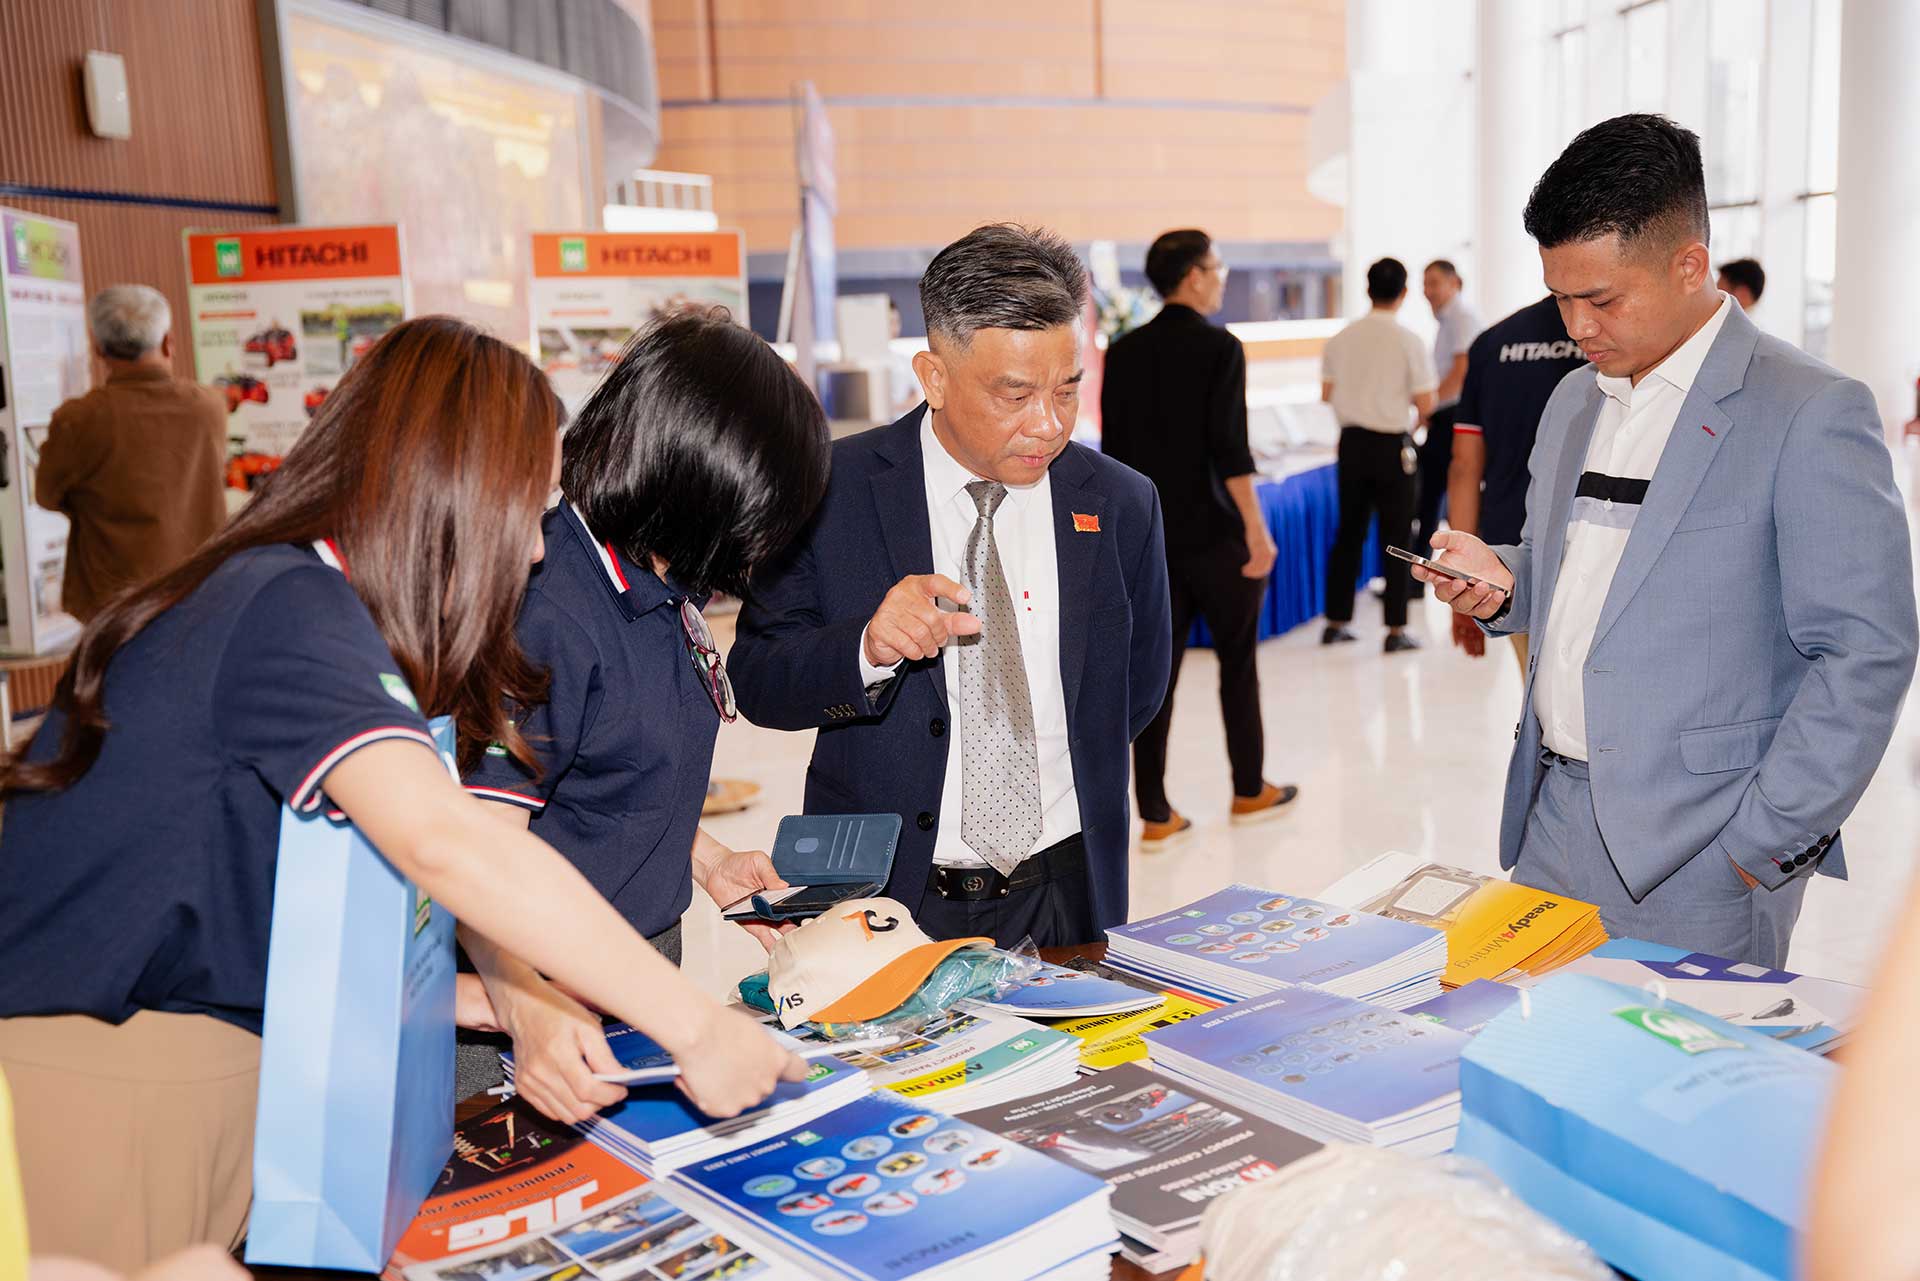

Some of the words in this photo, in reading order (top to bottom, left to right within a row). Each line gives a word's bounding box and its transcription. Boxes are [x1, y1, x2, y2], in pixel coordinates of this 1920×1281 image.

[255, 241, 368, 269] HITACHI
[601, 244, 712, 264] HITACHI
[1454, 900, 1558, 969] Ready4Mining
[1075, 1017, 1113, 1031] LINEUP
[1112, 1003, 1164, 1021] PRODUCT
[1202, 1130, 1255, 1155] PRODUCT
[507, 1162, 576, 1193] PRODUCT
[448, 1180, 598, 1251] JLG
